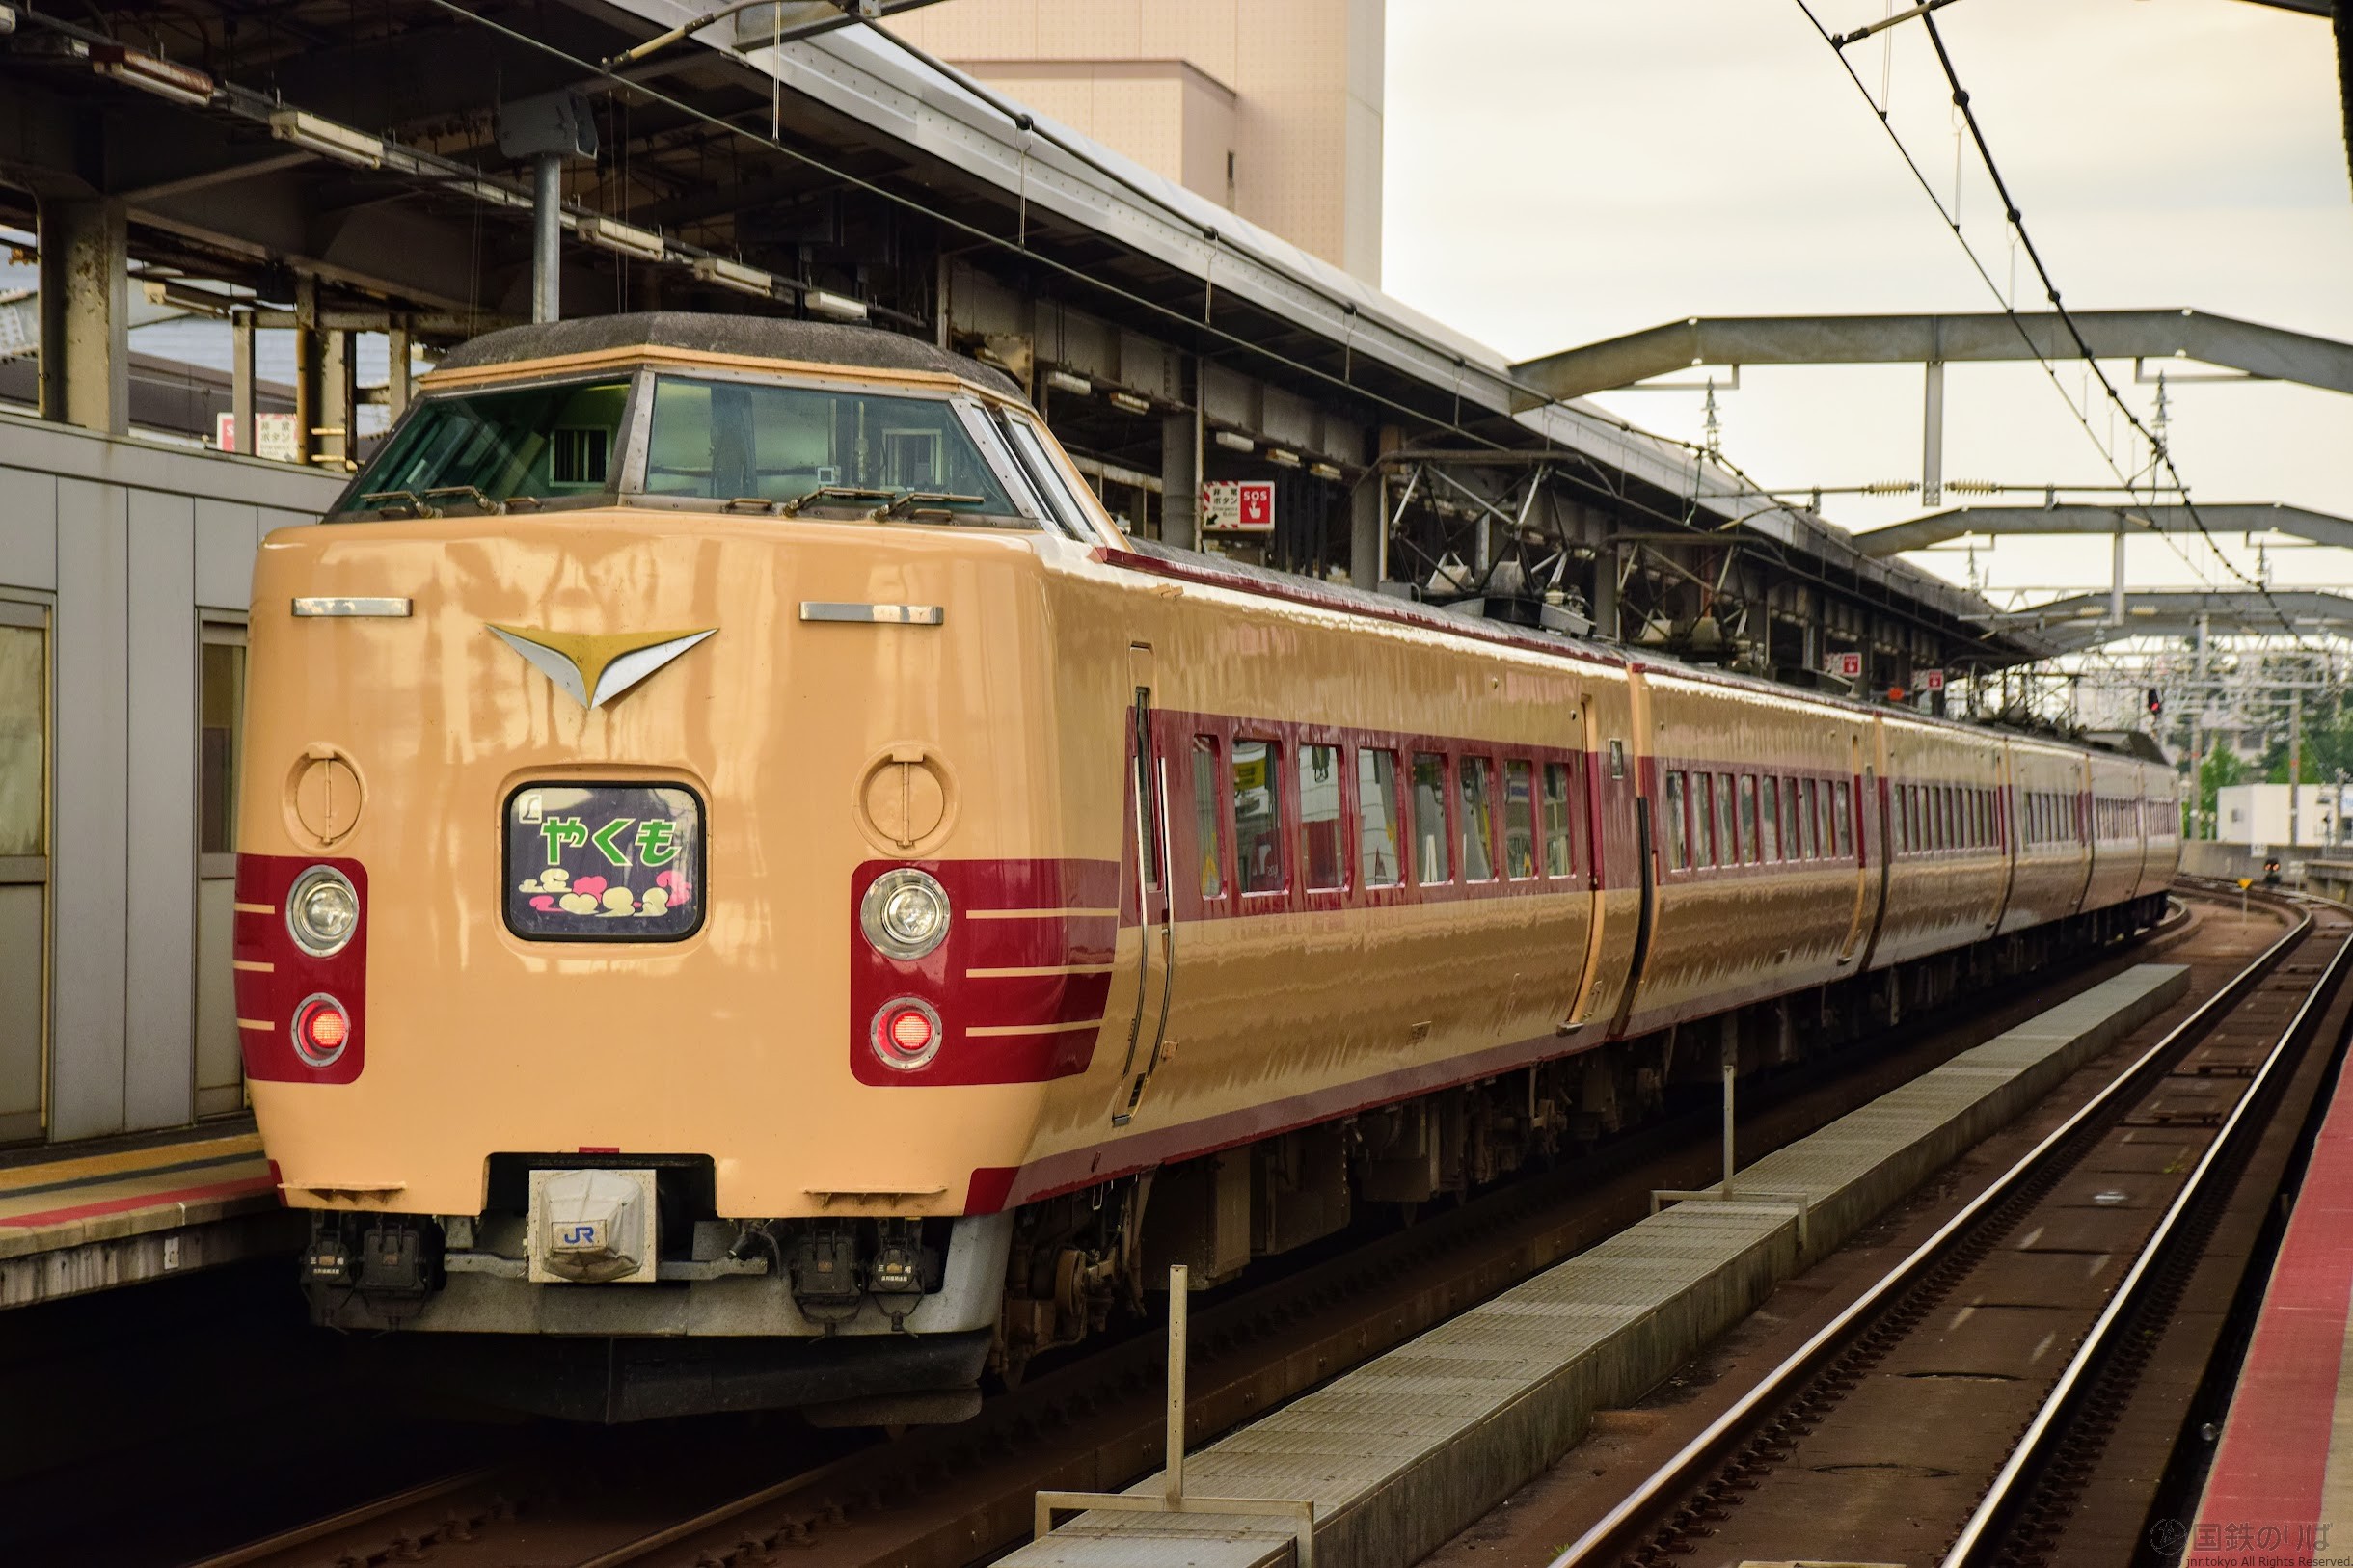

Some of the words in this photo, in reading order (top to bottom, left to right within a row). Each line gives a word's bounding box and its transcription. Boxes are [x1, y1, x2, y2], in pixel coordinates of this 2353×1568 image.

[1243, 490, 1267, 501] SOS
[539, 816, 682, 867] やくも
[564, 1226, 594, 1244] JR
